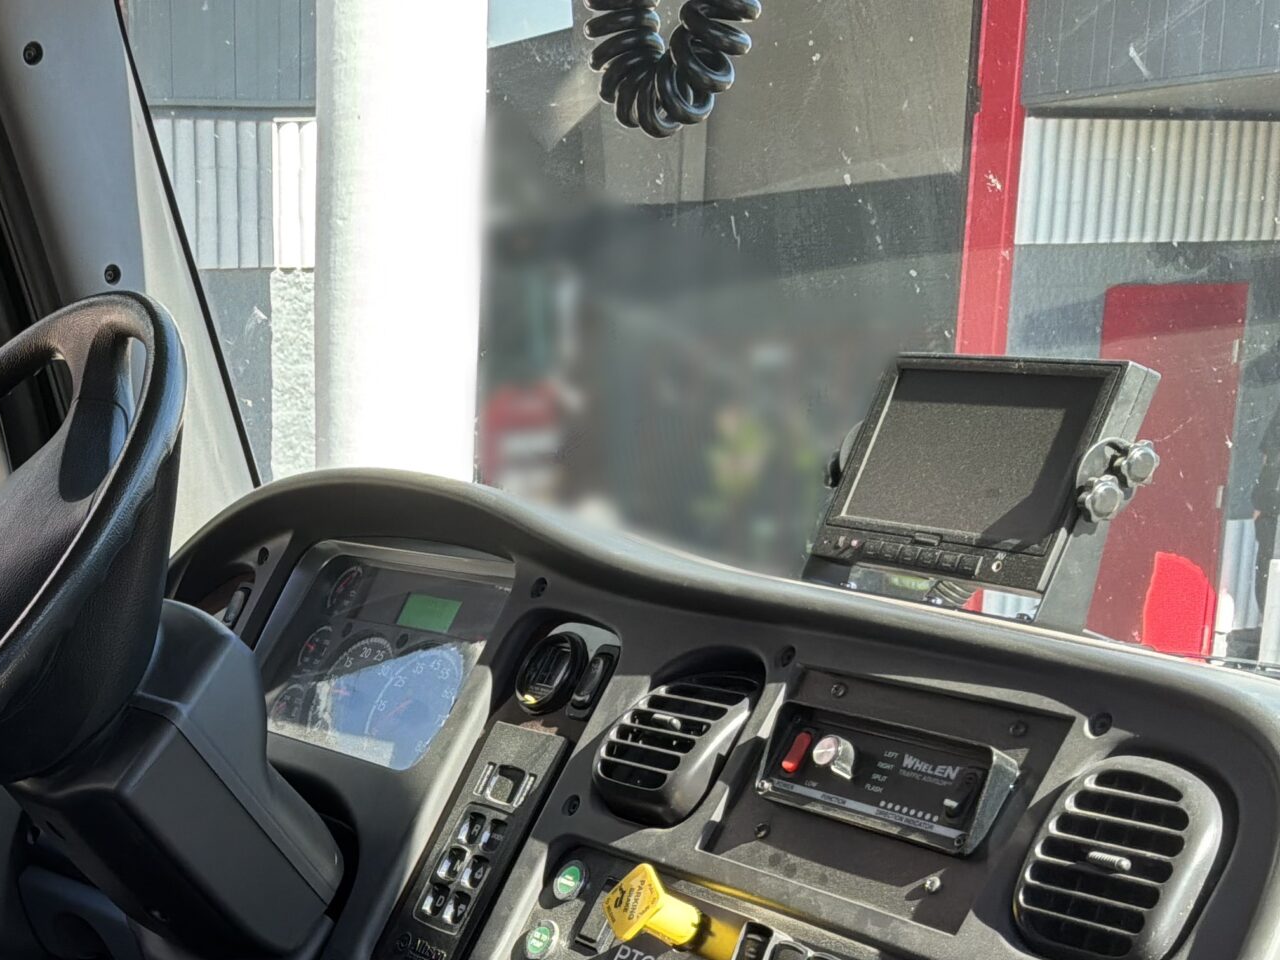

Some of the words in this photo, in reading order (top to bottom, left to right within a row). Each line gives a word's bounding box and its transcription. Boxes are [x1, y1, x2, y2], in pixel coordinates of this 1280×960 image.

[360, 647, 372, 659] 20
[373, 650, 385, 661] 25
[344, 657, 353, 668] 15
[430, 660, 442, 671] 45
[413, 663, 424, 674] 35
[438, 668, 450, 680] 55
[393, 675, 407, 688] 25
[378, 701, 386, 712] 15
[883, 751, 899, 759] LEFT
[871, 773, 888, 782] SPLIT
[864, 783, 884, 793] FLASH
[471, 824, 481, 836] R
[453, 860, 463, 872] N
[435, 895, 446, 908] D
[627, 879, 646, 921] PARKING
